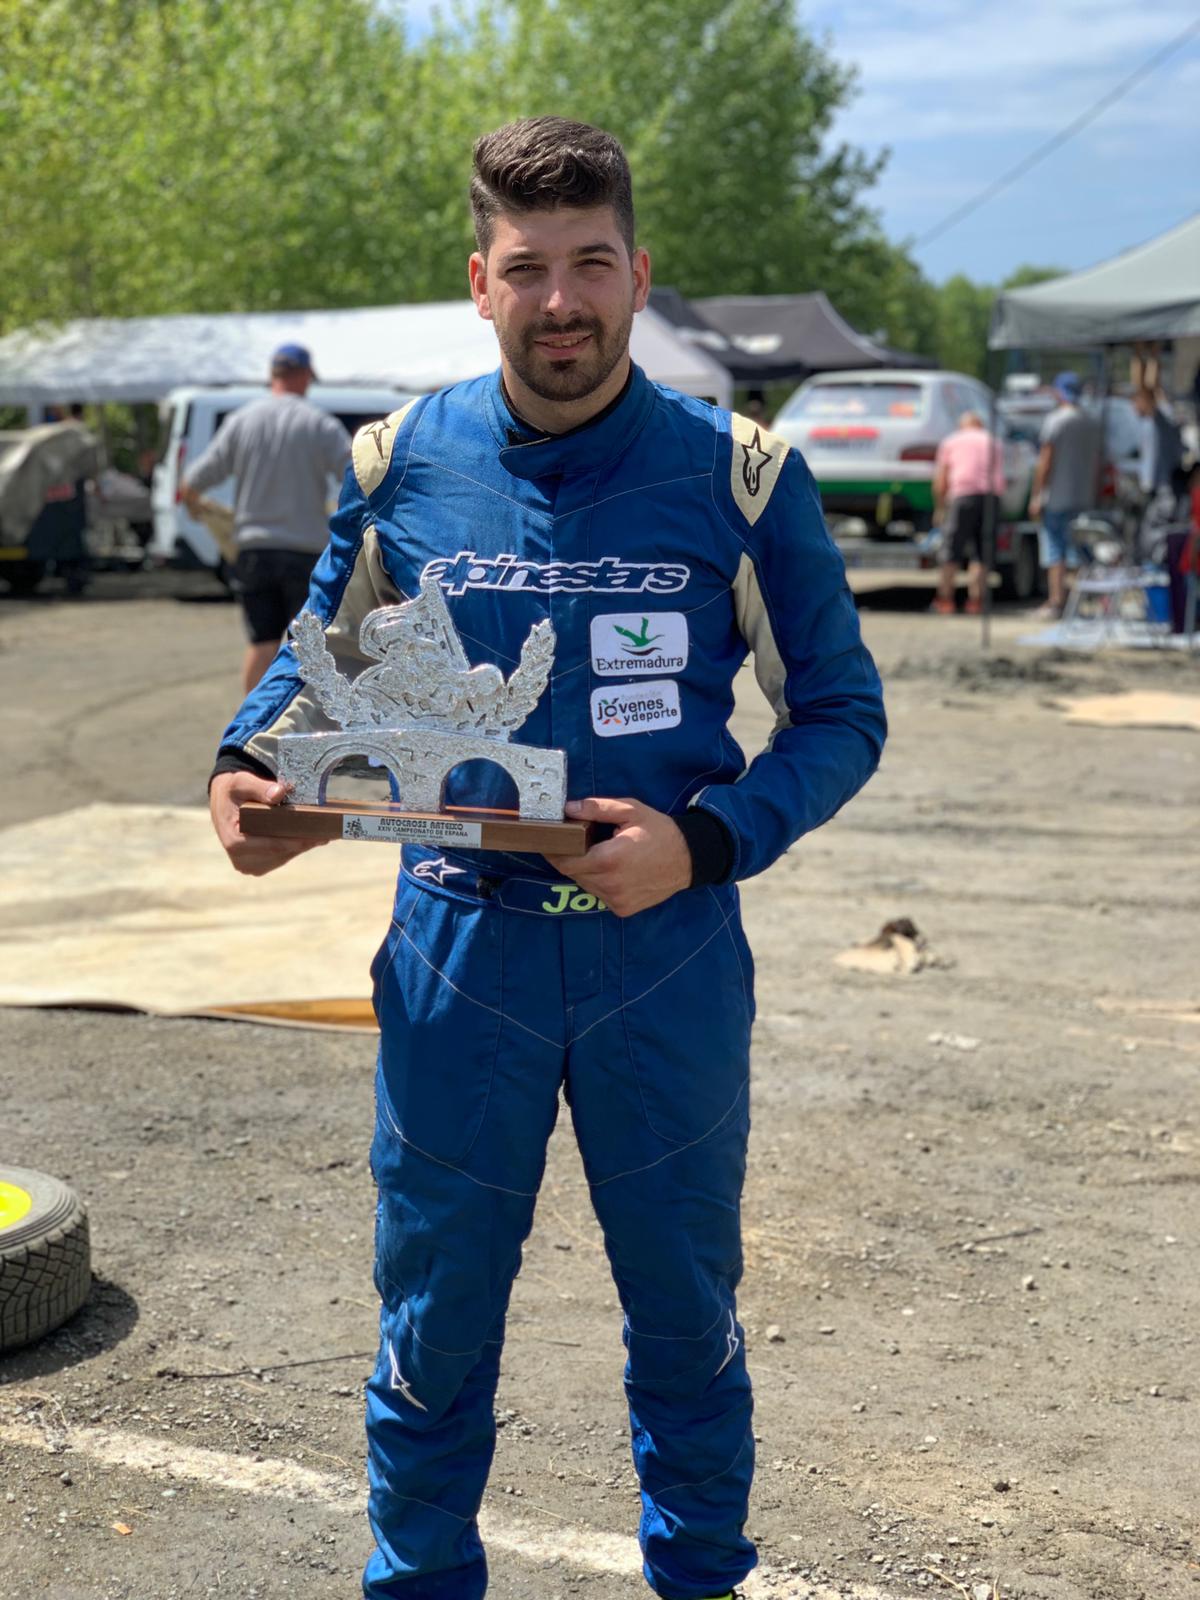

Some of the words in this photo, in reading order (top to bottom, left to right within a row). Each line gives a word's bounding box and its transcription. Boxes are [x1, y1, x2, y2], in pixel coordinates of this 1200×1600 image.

[420, 551, 690, 595] alpinestars
[596, 656, 684, 671] Extremadura
[380, 818, 427, 828] AUTOCROSS
[430, 821, 464, 831] ARTEIXO
